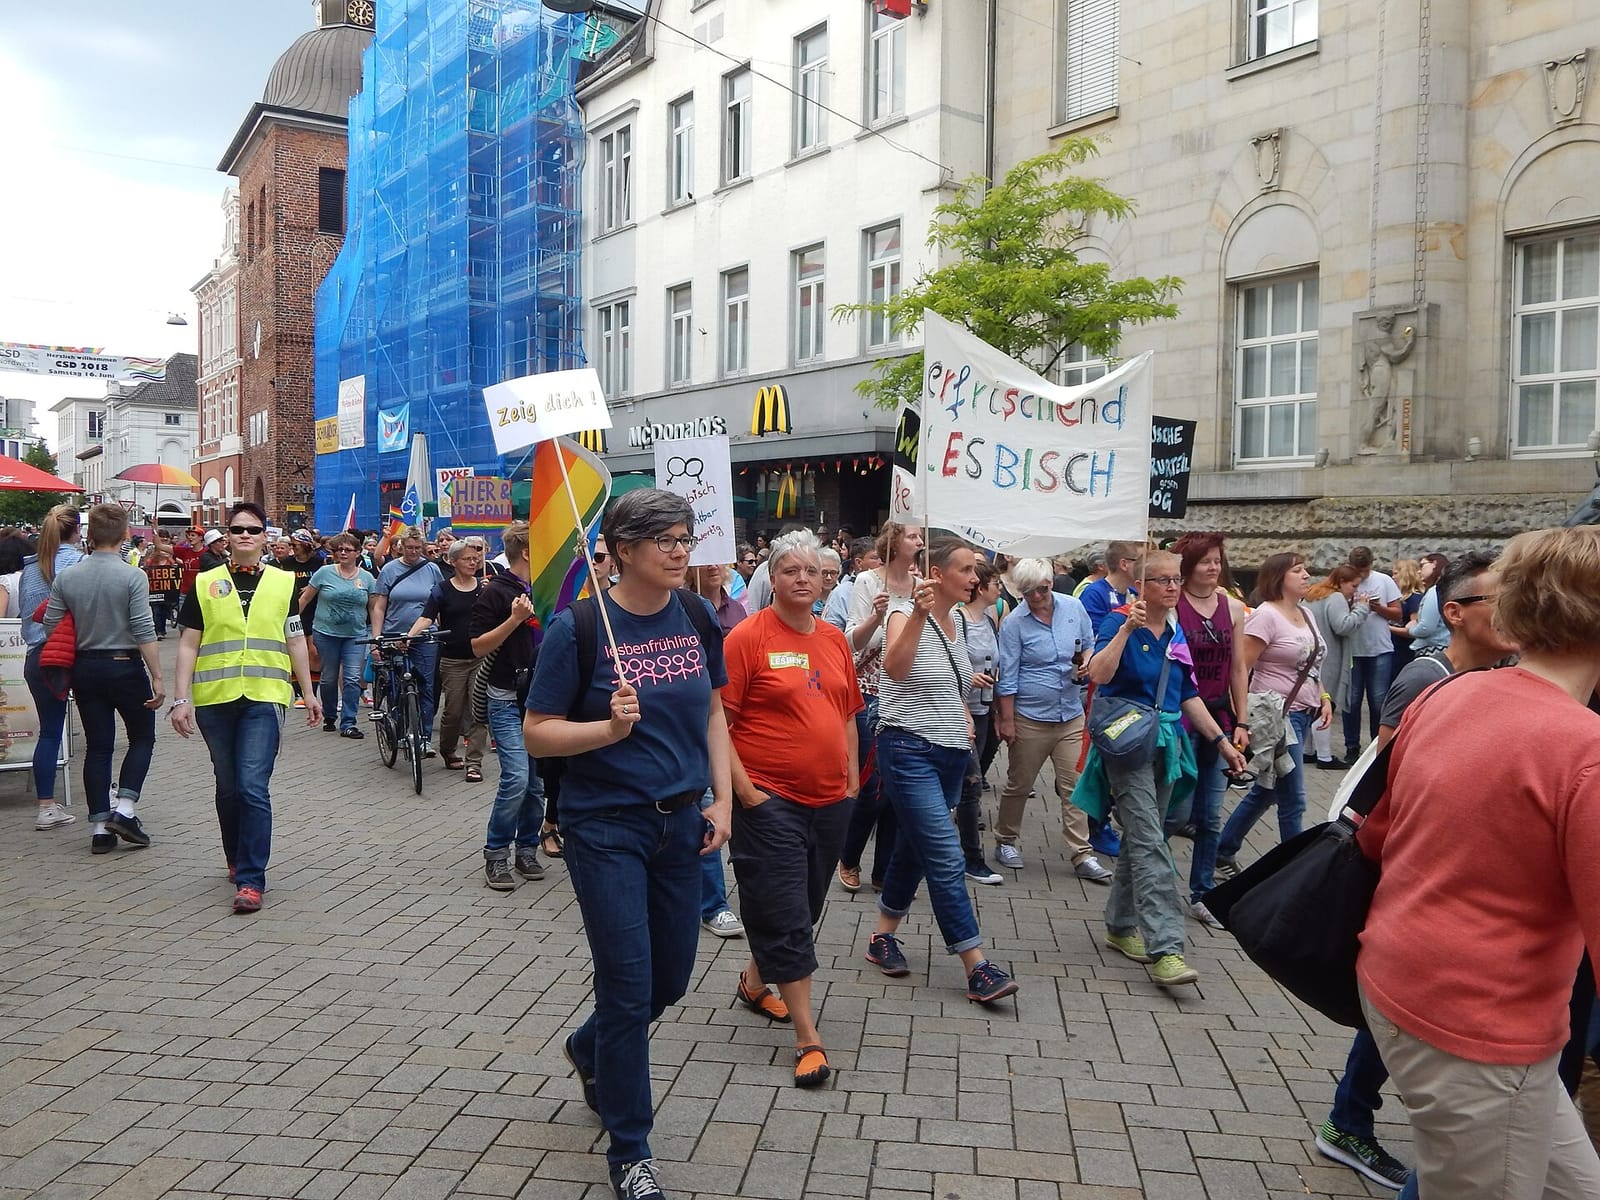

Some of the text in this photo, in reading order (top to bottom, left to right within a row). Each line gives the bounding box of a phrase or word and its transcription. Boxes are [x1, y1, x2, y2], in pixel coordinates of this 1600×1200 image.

[48, 369, 82, 378] Samstag
[55, 360, 109, 371] CSD 2018
[928, 361, 1129, 432] erfrischend
[497, 400, 537, 427] Zeig
[545, 391, 584, 413] dich
[628, 415, 727, 450] McDonald's
[928, 424, 1116, 498] ESBISCH
[455, 480, 511, 502] HIER &
[1150, 489, 1173, 513] OG
[604, 635, 700, 659] lesbenfrühling
